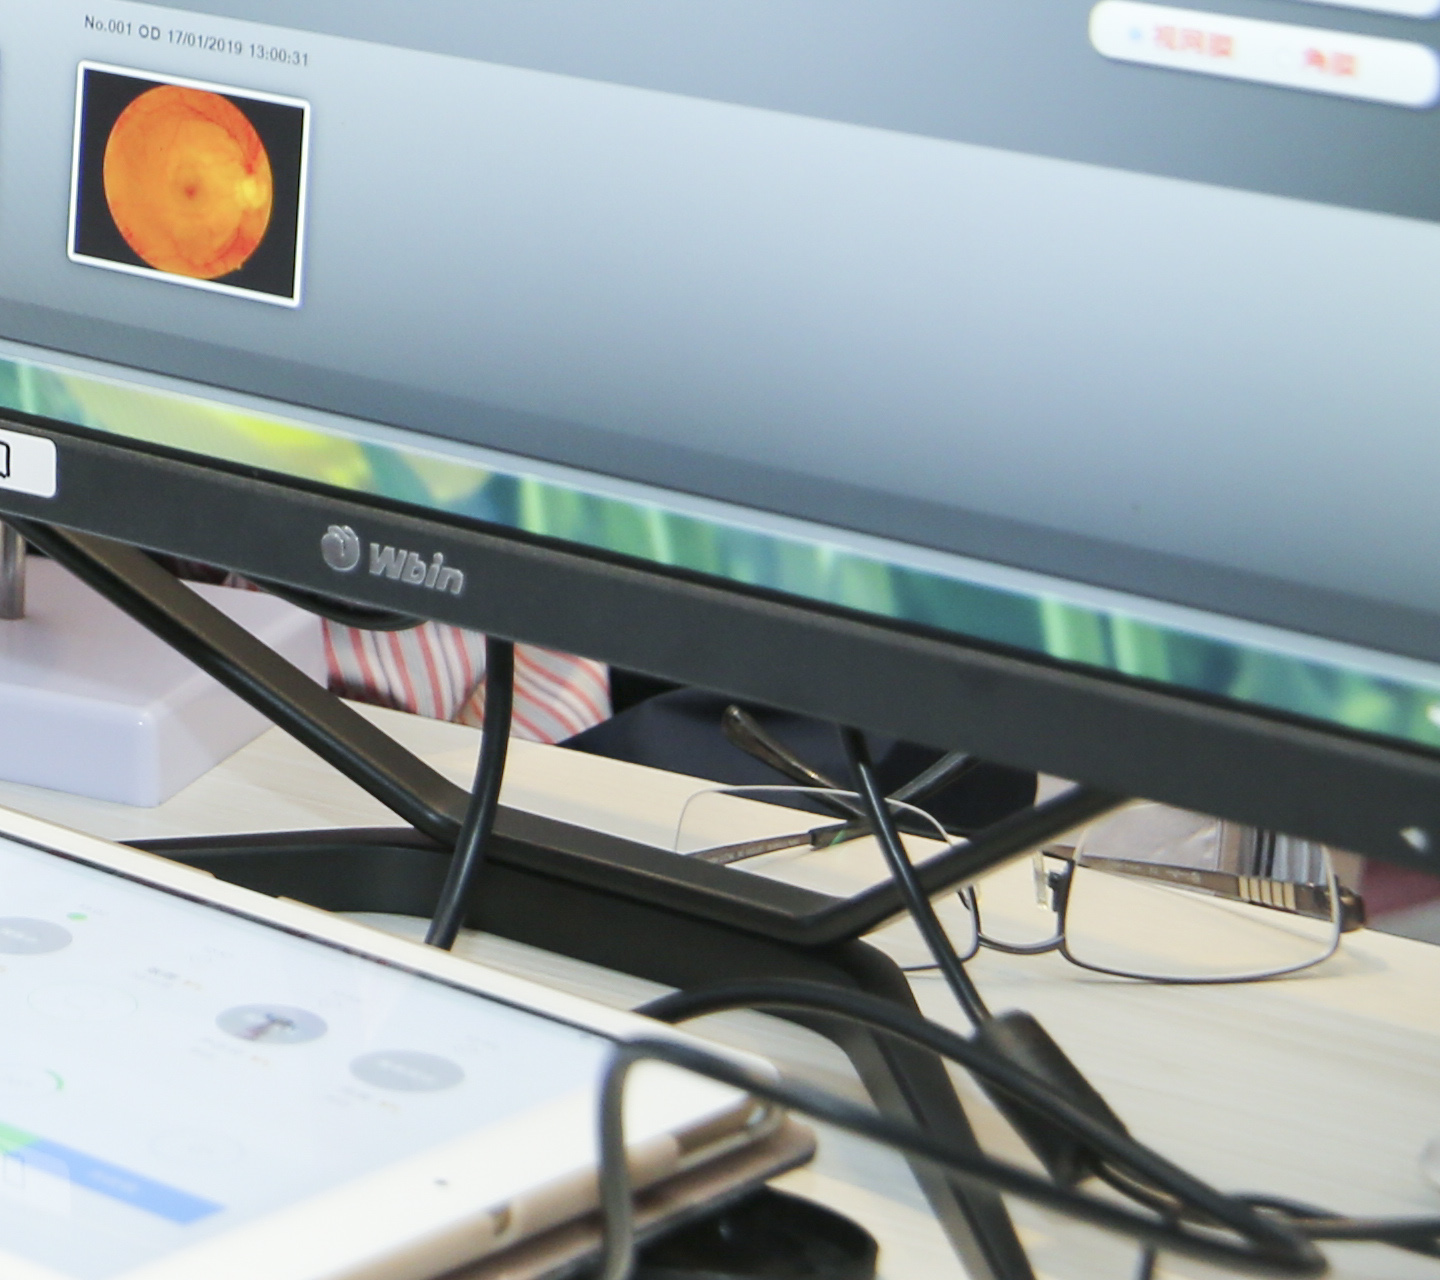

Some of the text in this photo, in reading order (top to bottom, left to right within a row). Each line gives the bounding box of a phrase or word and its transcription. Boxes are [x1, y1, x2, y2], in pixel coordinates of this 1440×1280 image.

[84, 14, 309, 67] No.001 OD 17/01/2019 13:00:31
[368, 542, 464, 595] Wbin
